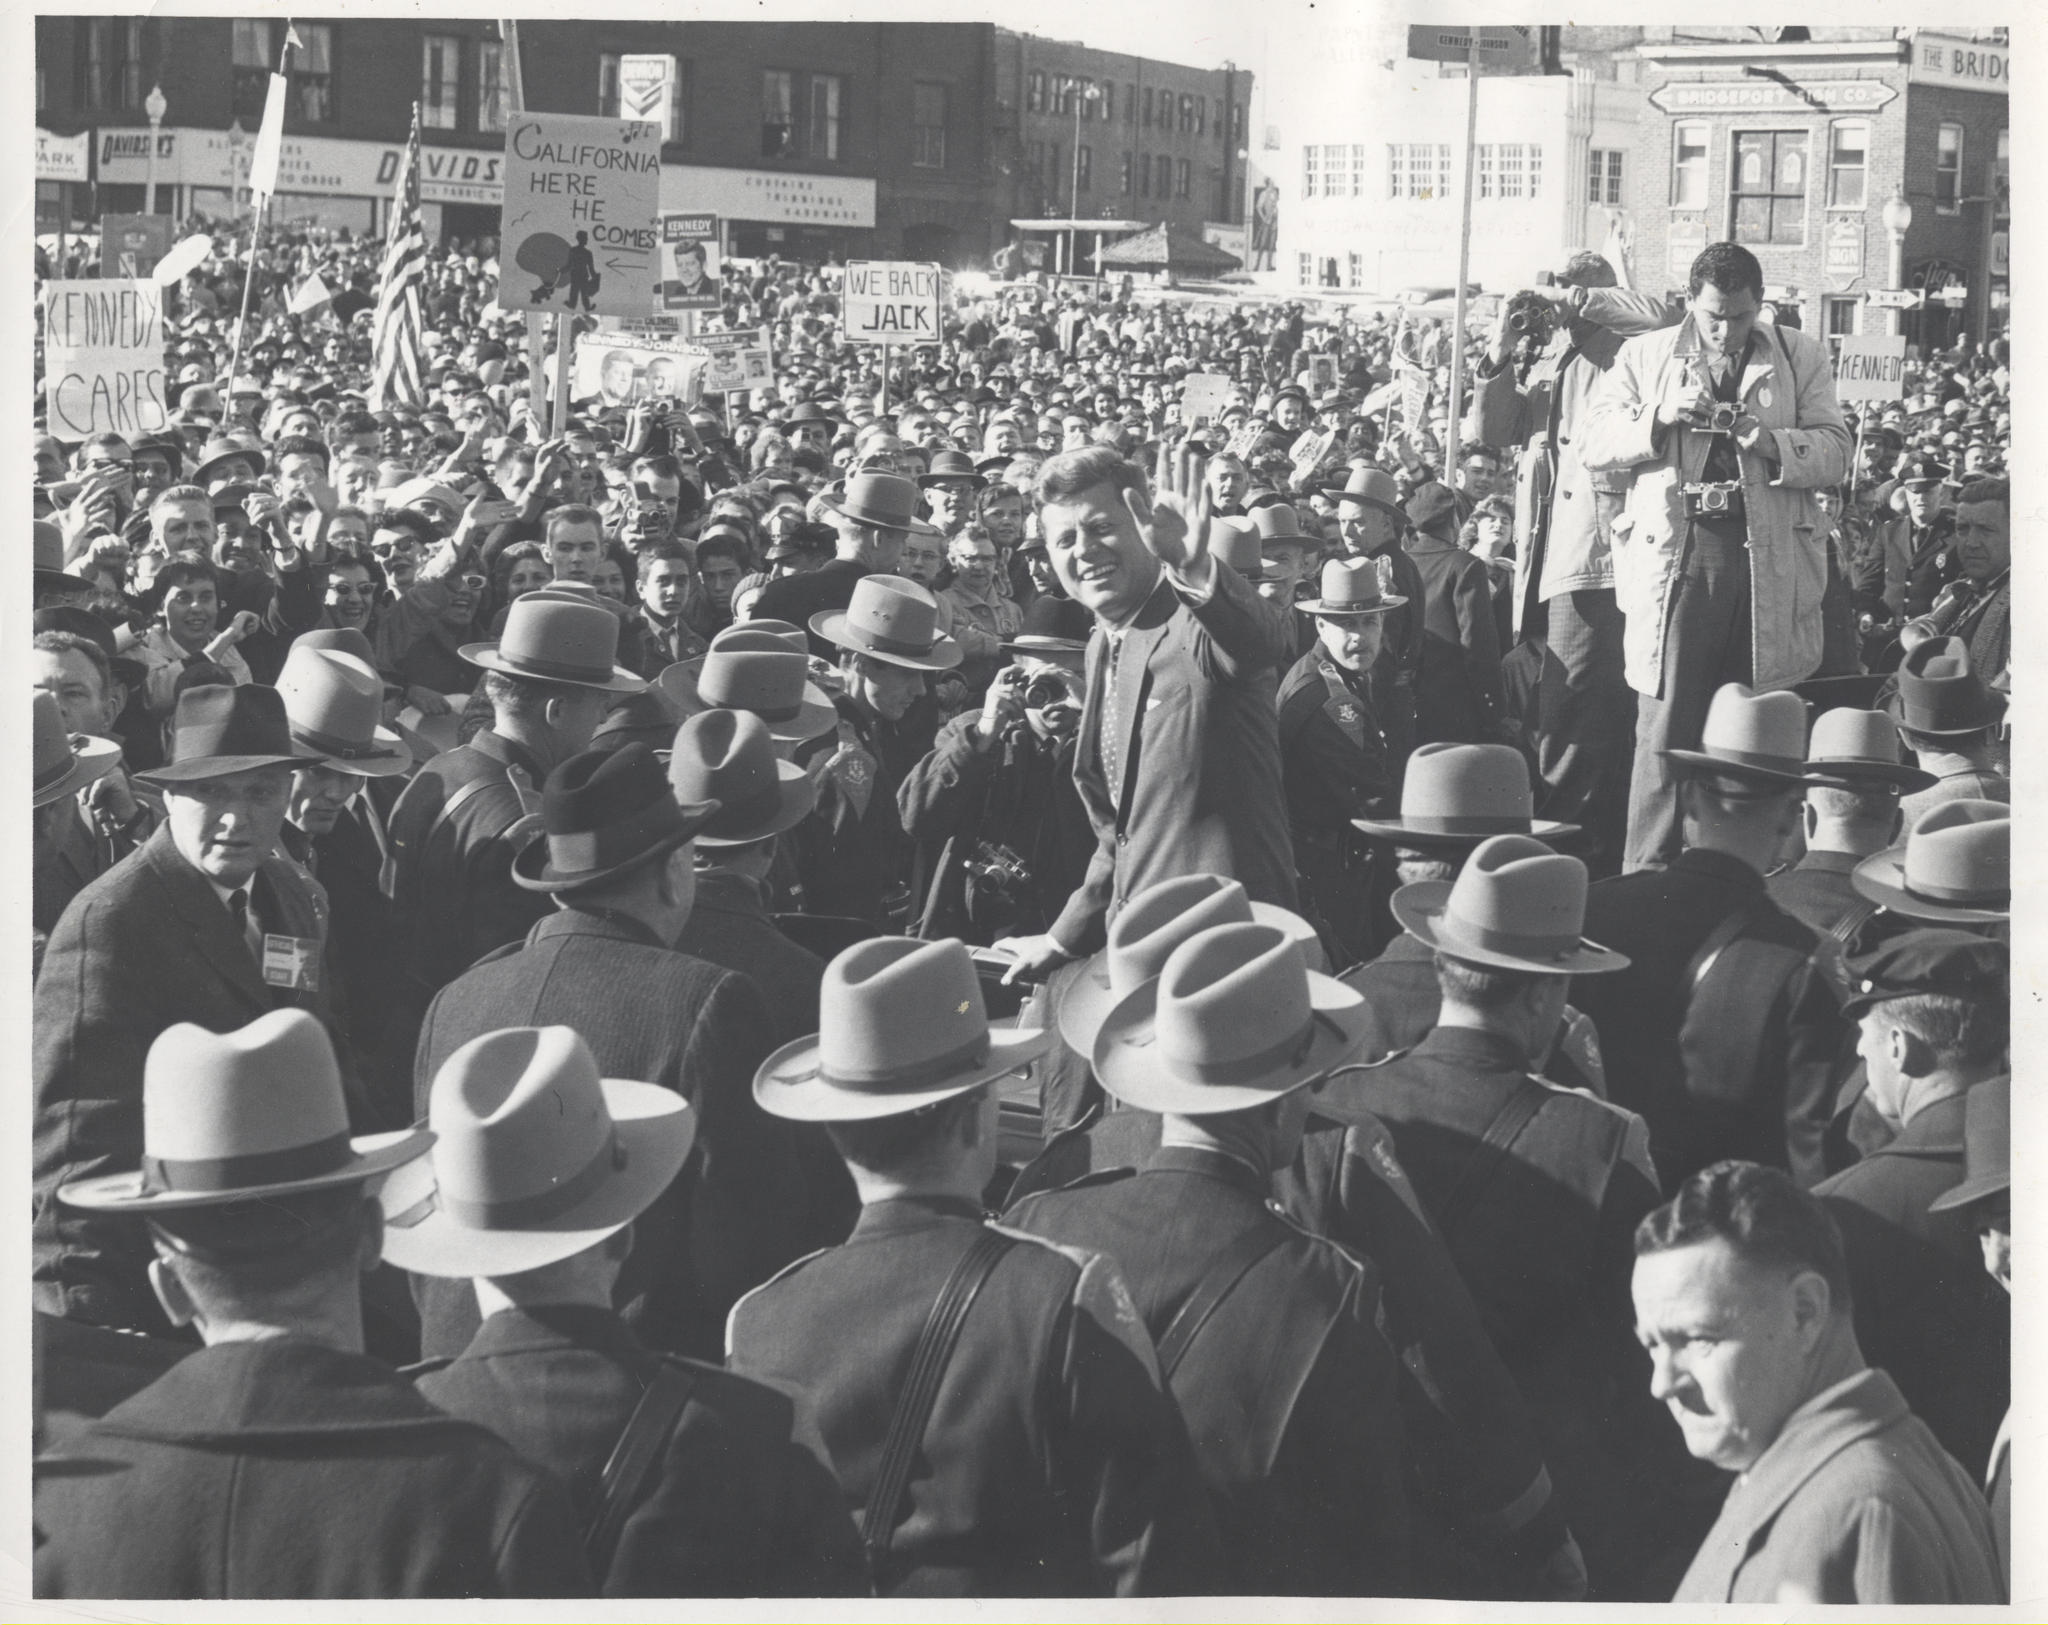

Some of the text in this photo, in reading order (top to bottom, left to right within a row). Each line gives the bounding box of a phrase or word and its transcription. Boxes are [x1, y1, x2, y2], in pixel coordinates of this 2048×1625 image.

[1922, 48, 1943, 68] THE
[1676, 88, 1788, 105] BRIDGEPORT
[1843, 86, 1872, 104] CO.
[36, 152, 75, 165] ARK
[101, 135, 175, 165] DAVIDSN'S
[513, 123, 660, 175] CALIFORNIA
[376, 151, 499, 184] DVIDS
[530, 172, 598, 196] HERE
[572, 199, 606, 222] HE
[592, 225, 657, 249] COMES
[667, 219, 713, 232] KENNEDY
[849, 269, 935, 297] WE BACK
[47, 290, 158, 349] KENNEDY
[862, 304, 930, 331] JACK
[55, 369, 166, 434] CARES
